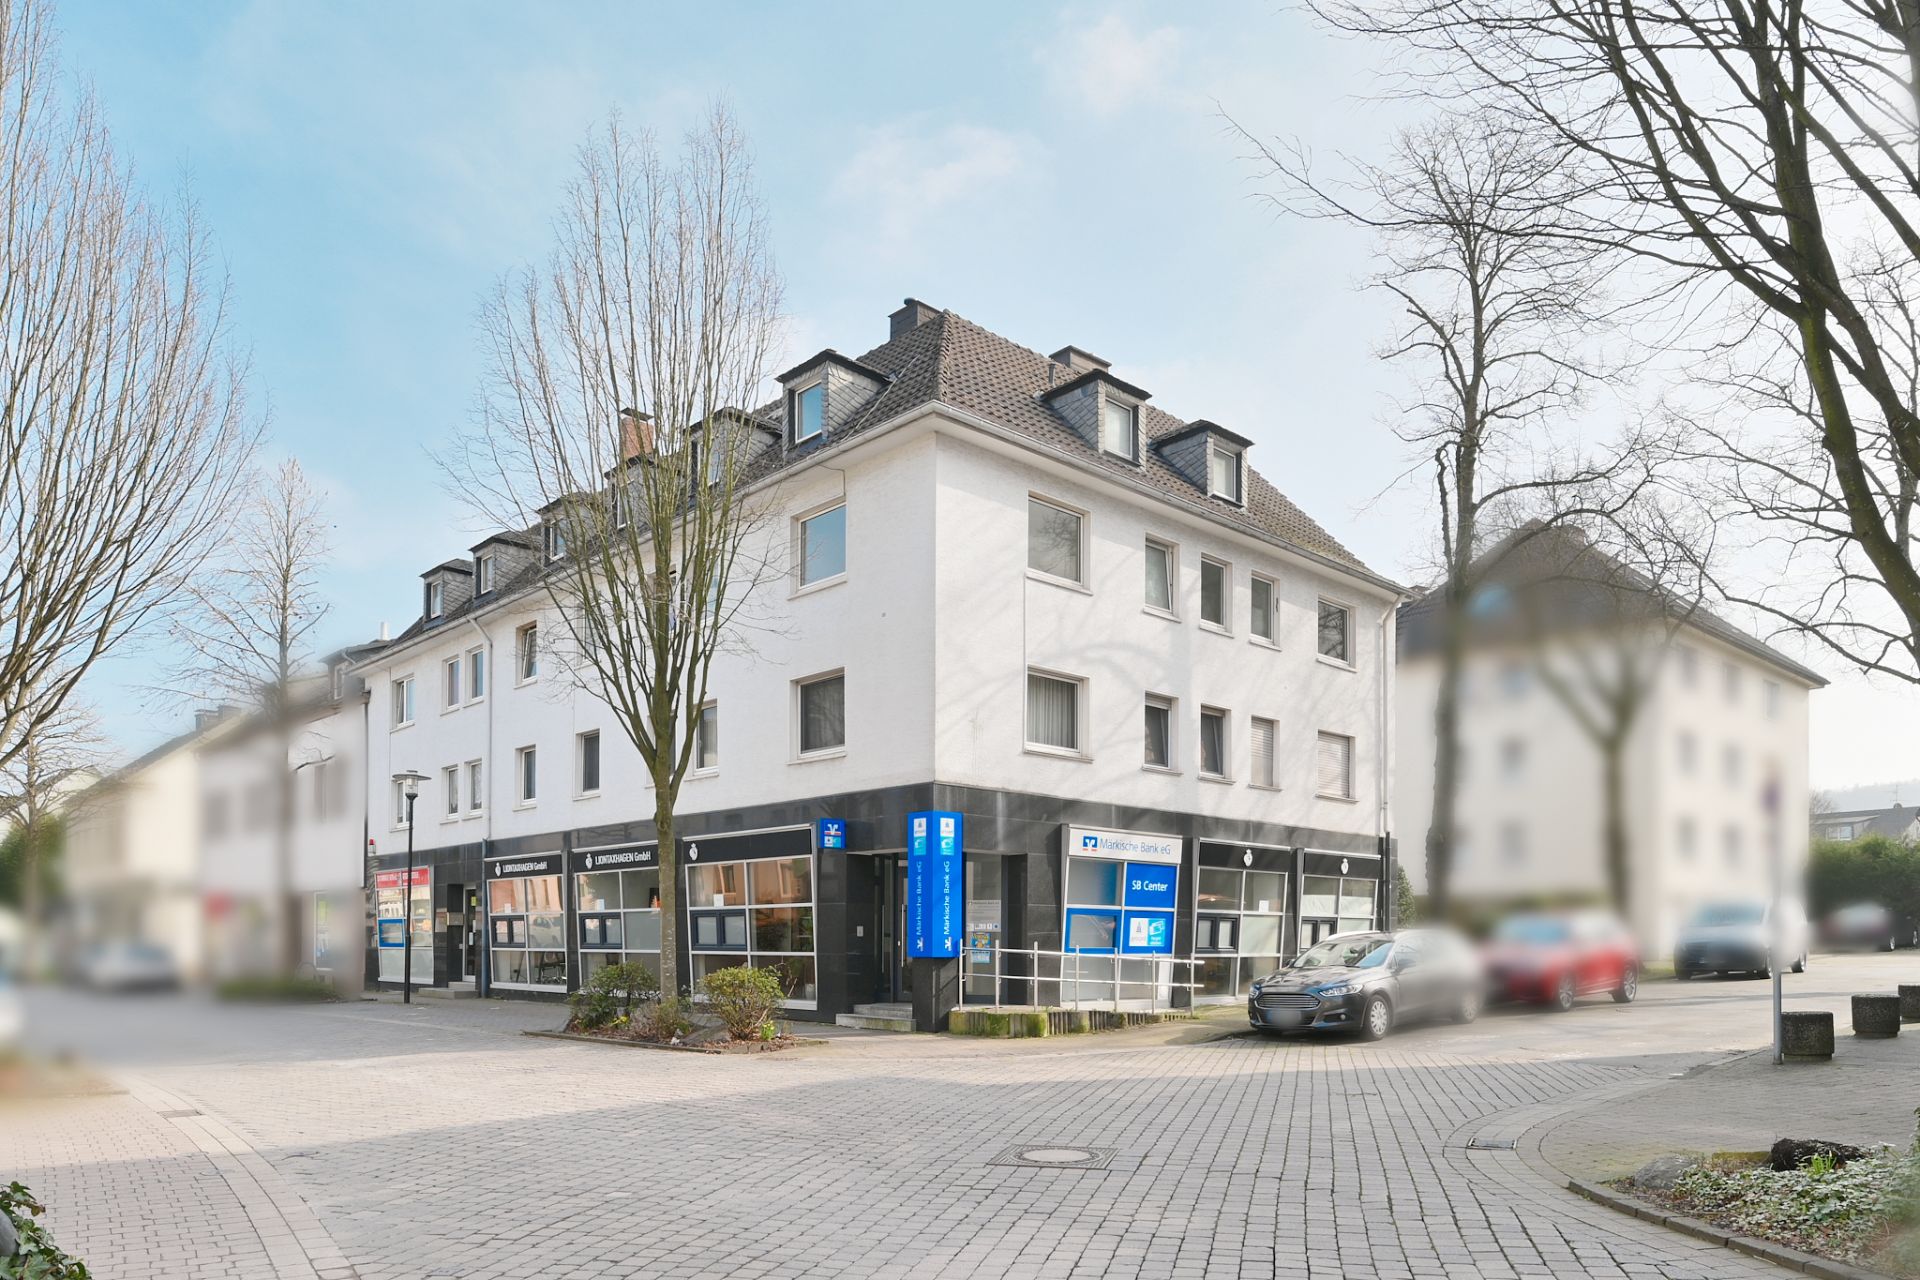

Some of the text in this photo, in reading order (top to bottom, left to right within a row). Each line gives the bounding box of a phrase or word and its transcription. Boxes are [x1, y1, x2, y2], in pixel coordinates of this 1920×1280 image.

[1100, 838, 1171, 855] Märkische Bank eG
[634, 850, 651, 862] GmbH
[944, 860, 950, 872] eG
[1131, 880, 1168, 892] SB Center
